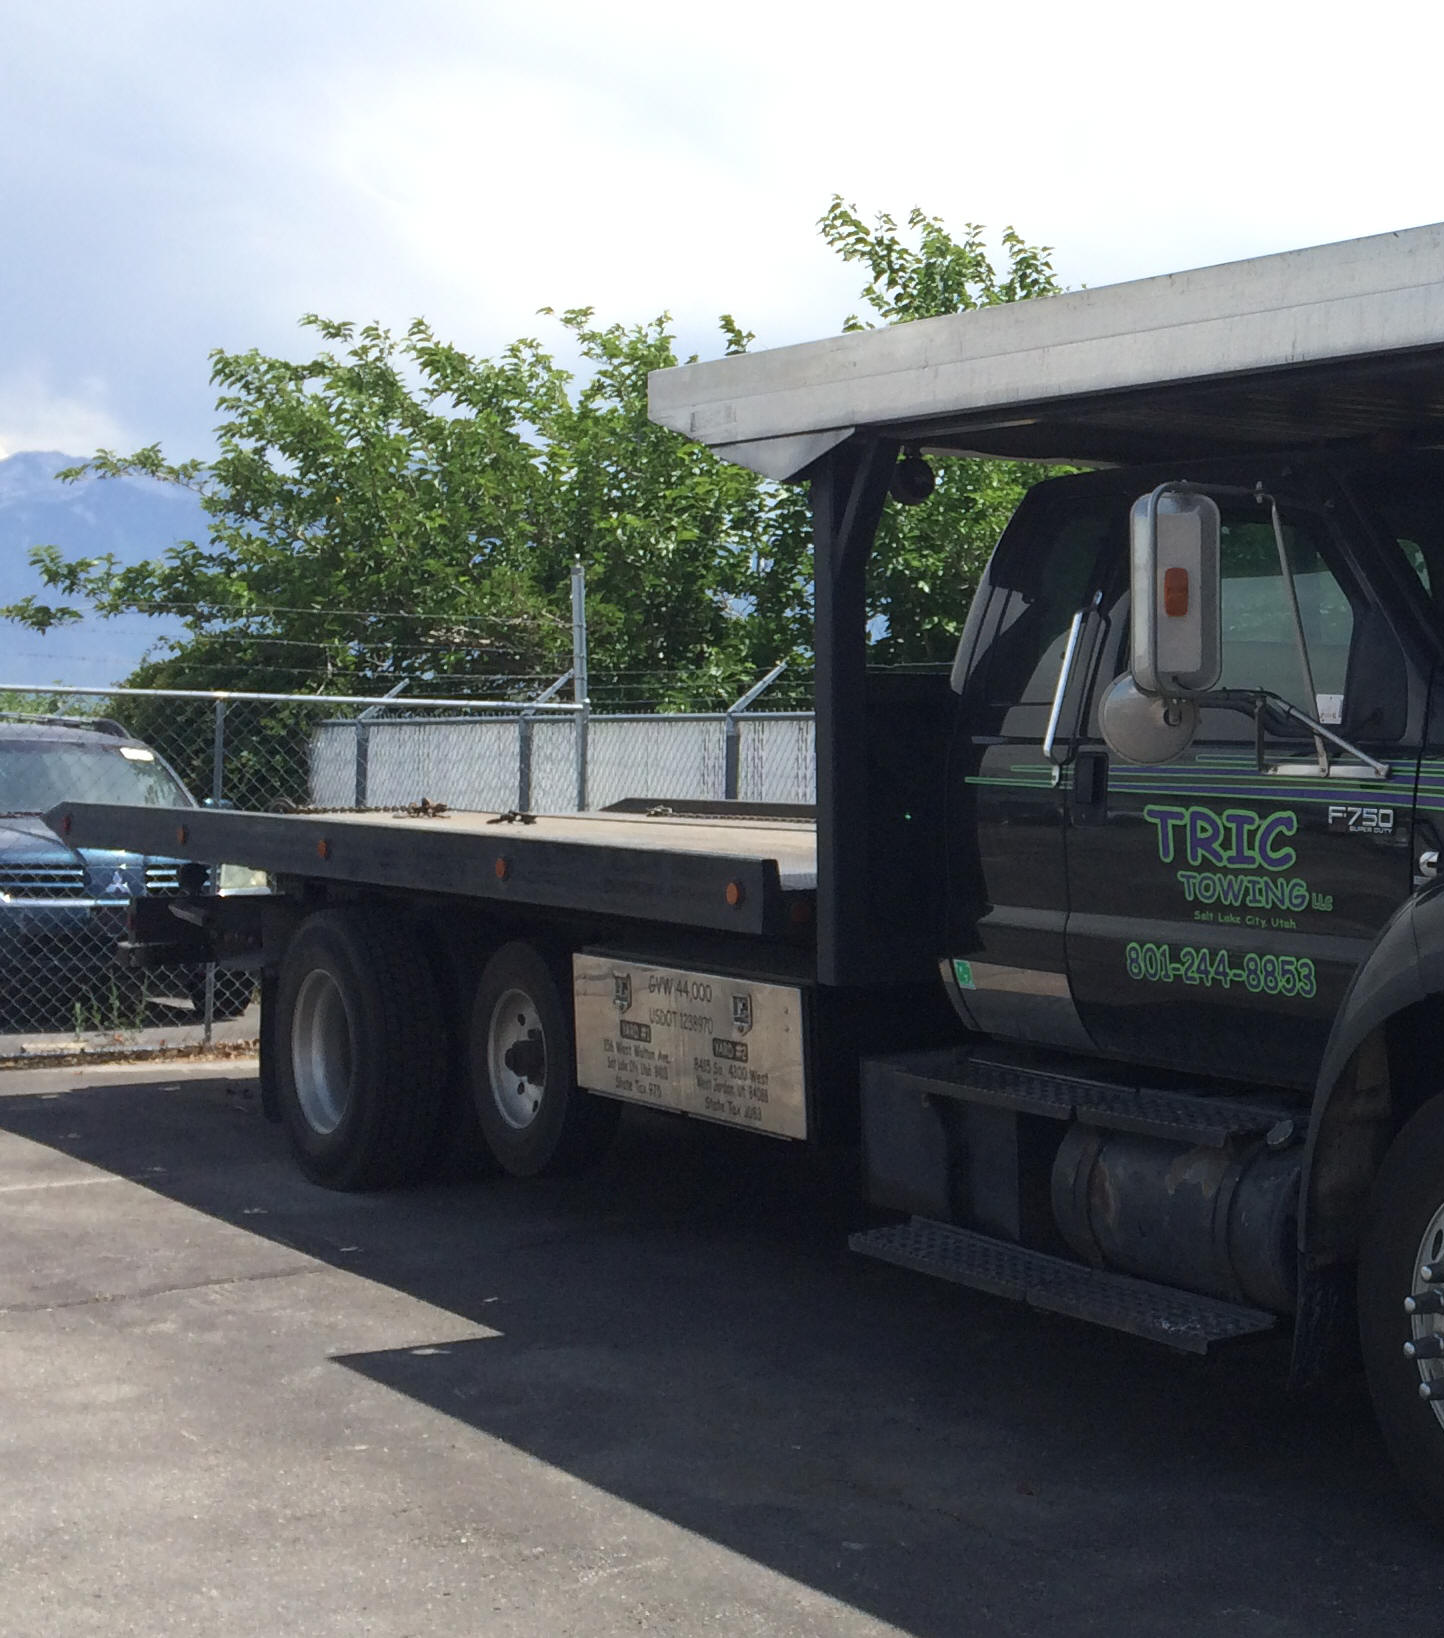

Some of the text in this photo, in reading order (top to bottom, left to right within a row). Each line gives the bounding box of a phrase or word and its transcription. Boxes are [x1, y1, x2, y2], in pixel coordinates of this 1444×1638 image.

[1144, 805, 1297, 871] TRIC
[1177, 871, 1310, 912] TOWING
[1194, 910, 1213, 921] Salt
[1218, 912, 1241, 924] Lake
[1271, 918, 1297, 930] Utah
[1126, 942, 1316, 998] 801-244-8853
[648, 975, 713, 1003] GVW 44,000
[649, 1008, 678, 1028] USDOT
